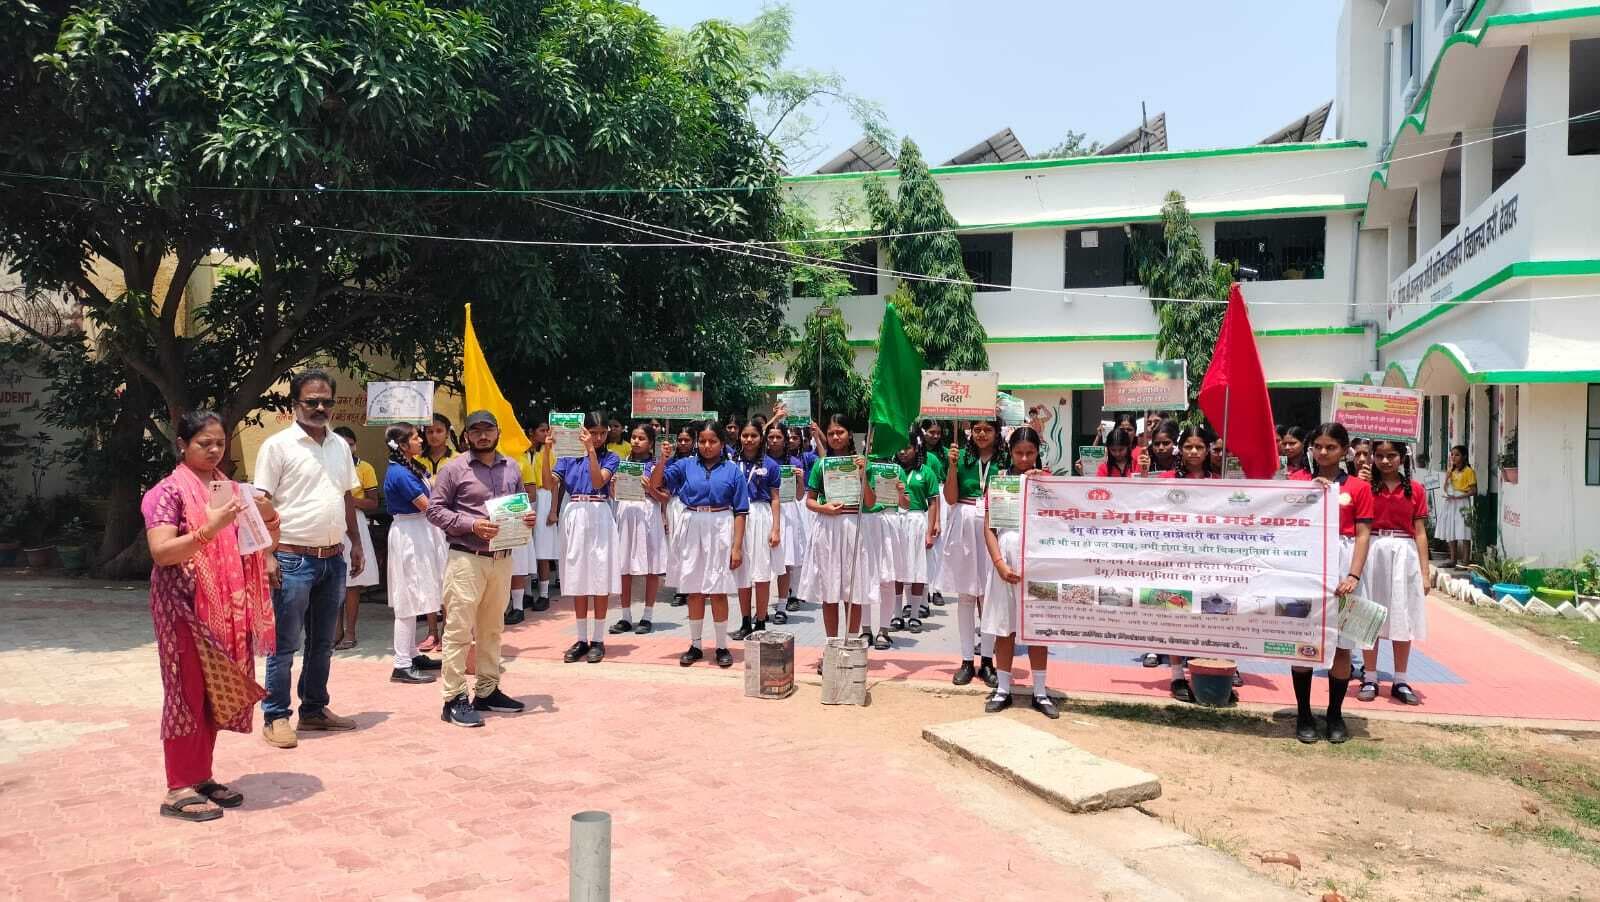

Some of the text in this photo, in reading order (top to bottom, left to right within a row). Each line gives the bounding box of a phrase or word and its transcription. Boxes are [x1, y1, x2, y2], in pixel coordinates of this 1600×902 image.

[1037, 508, 1097, 521] राष्ट्रीय
[1103, 509, 1134, 524] डेंगू
[1135, 510, 1188, 523] दिवस
[1195, 515, 1217, 524] 16
[1223, 513, 1256, 527] मई
